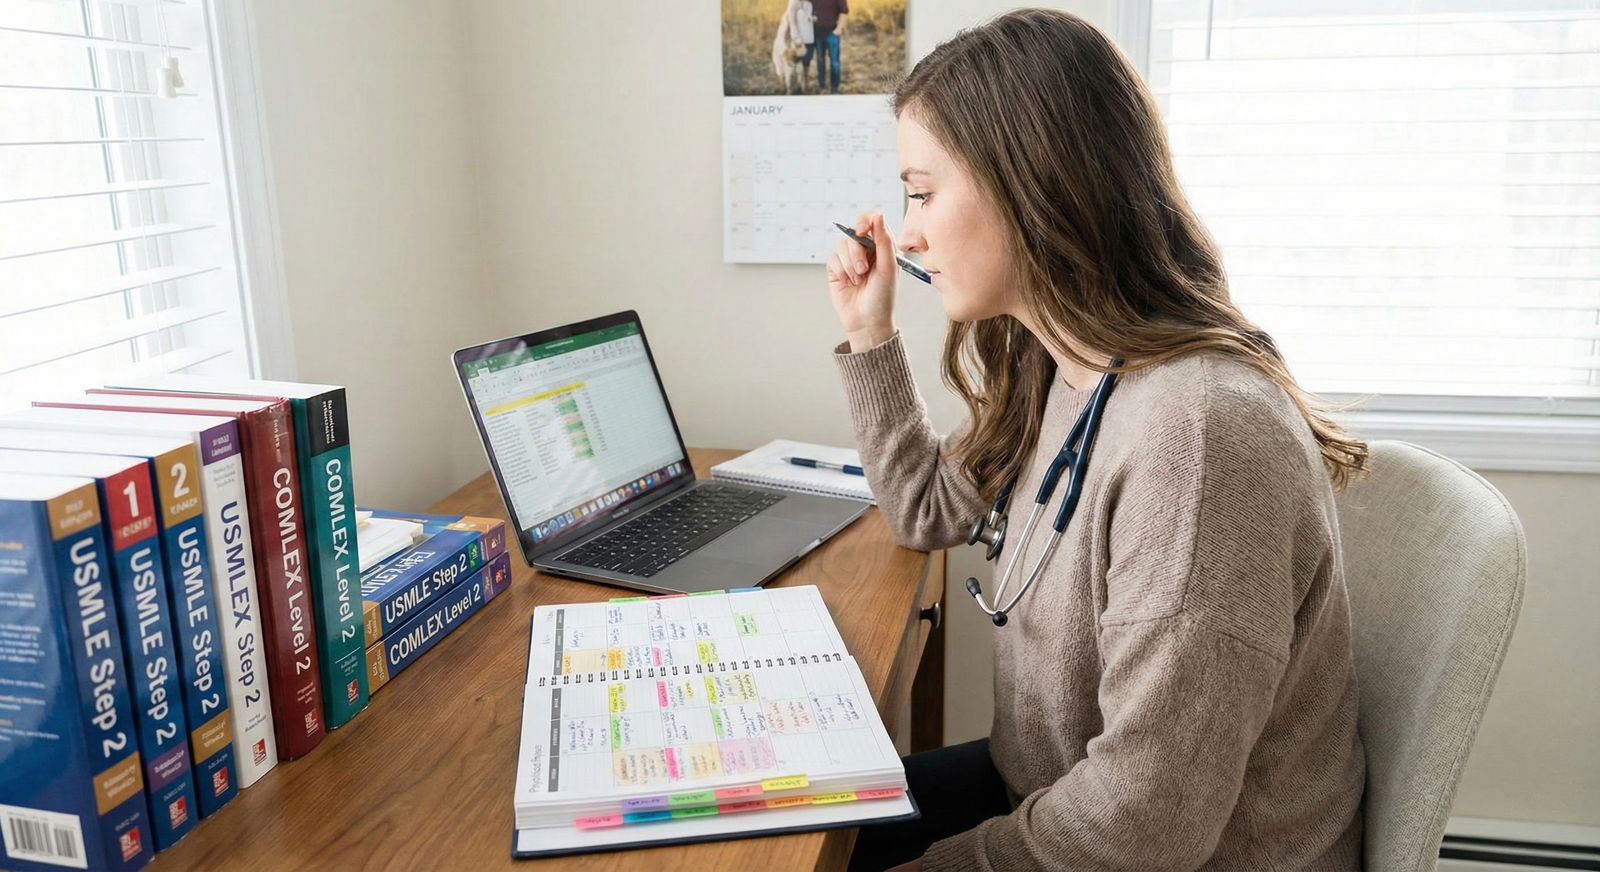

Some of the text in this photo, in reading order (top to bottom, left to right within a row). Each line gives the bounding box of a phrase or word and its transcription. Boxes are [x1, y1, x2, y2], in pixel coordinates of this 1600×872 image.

[730, 105, 784, 116] JANUARY
[123, 480, 140, 518] 1
[171, 461, 190, 499] 2
[325, 458, 349, 561] COMLEX
[273, 467, 303, 590] COMLEX
[178, 526, 209, 628] USMLE
[220, 500, 252, 629] USMLEX
[335, 563, 354, 622] Level
[385, 576, 432, 624] USMLE
[433, 565, 458, 591] Step
[458, 552, 468, 573] 2
[69, 536, 111, 658] USMLE
[130, 547, 164, 656] USMLE
[287, 590, 310, 655] Level
[389, 609, 444, 666] COMLEX
[444, 588, 473, 625] Level
[473, 582, 481, 603] 2
[192, 629, 213, 692] Step
[237, 632, 255, 688] Step
[341, 624, 356, 643] 2
[91, 657, 118, 731] Step
[146, 656, 169, 721] Step
[295, 656, 311, 675] 2
[201, 693, 220, 715] 2
[244, 689, 261, 708] 2
[102, 731, 127, 759] 2
[155, 722, 177, 746] 2
